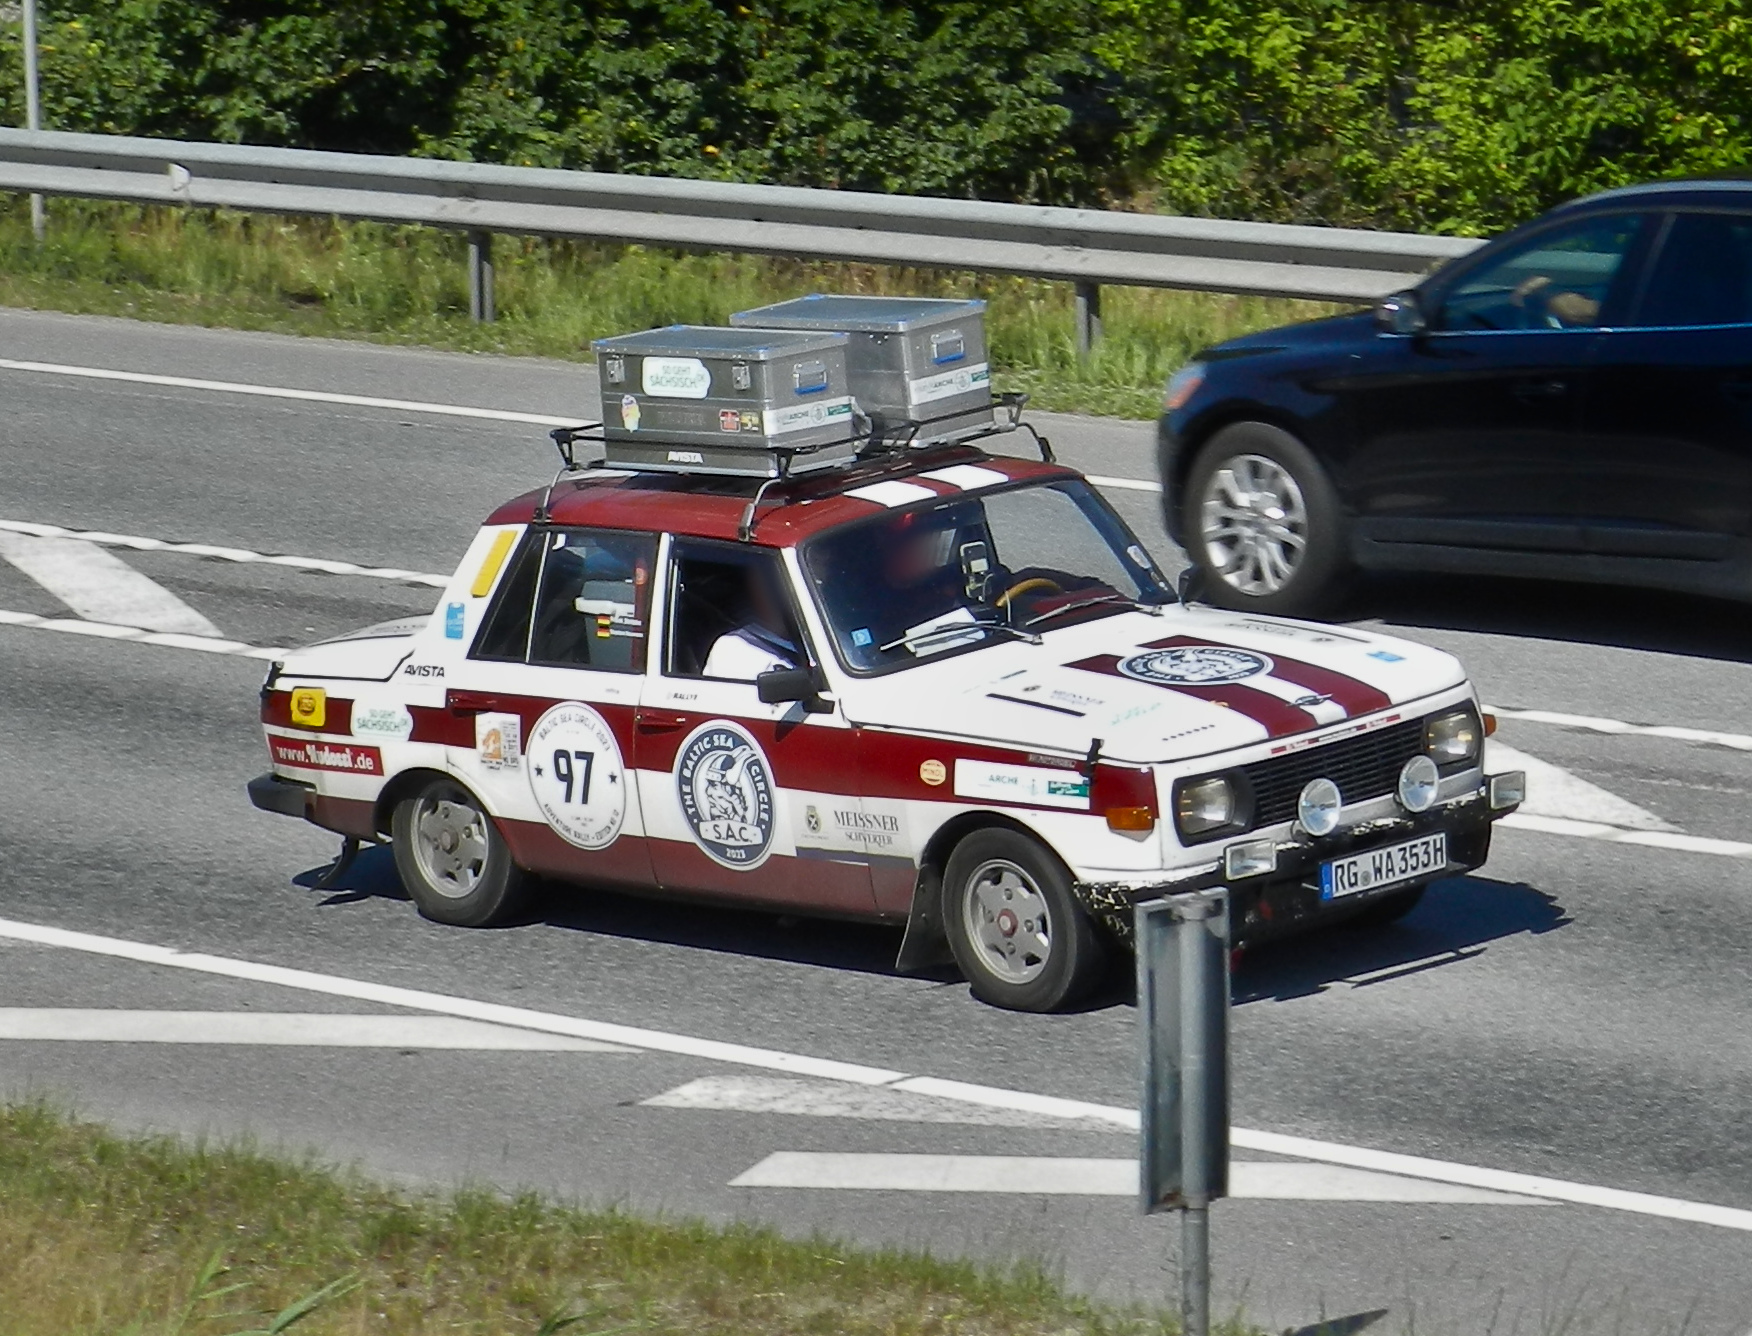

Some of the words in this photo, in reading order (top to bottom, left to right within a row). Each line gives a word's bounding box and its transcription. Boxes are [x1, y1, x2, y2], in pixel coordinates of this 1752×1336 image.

[404, 664, 445, 678] AVISTA
[682, 735, 712, 778] BALTIC
[712, 734, 735, 749] SEA
[553, 749, 595, 805] 97
[681, 784, 696, 815] THE
[750, 765, 770, 823] CIRCLE
[712, 822, 753, 843] S.A.C.
[833, 810, 900, 832] MEISSNER
[1334, 860, 1358, 893] RG
